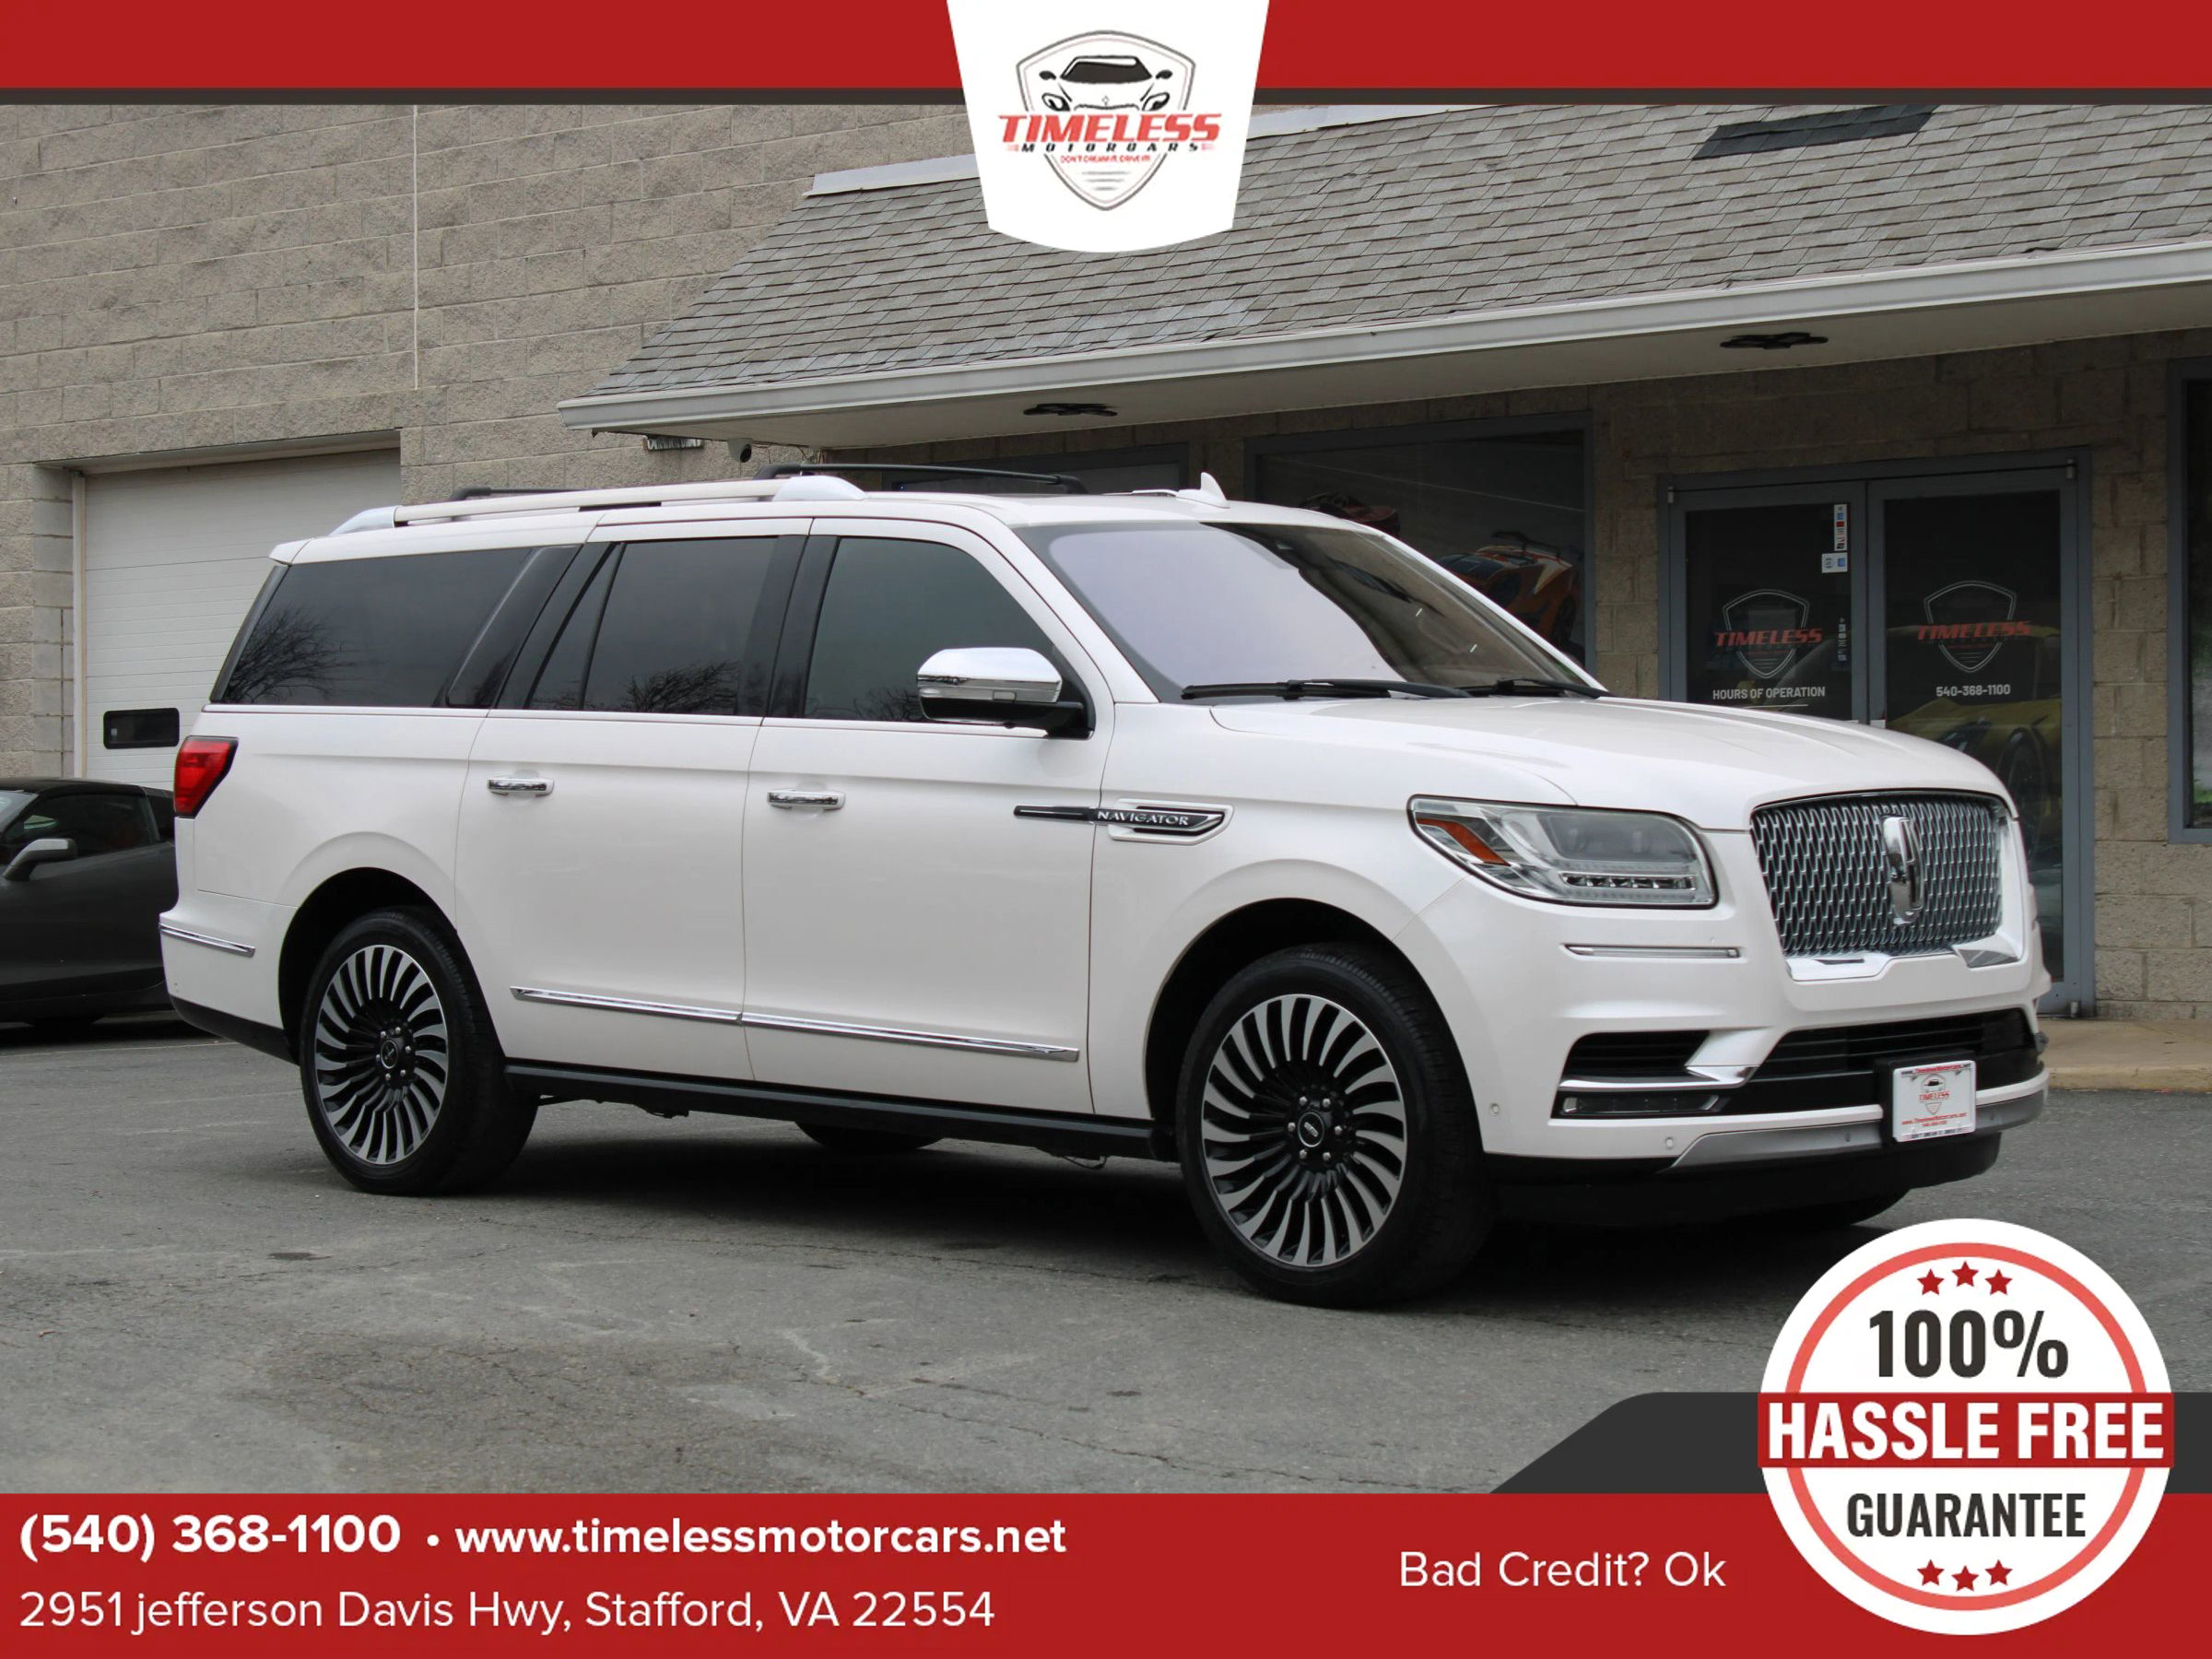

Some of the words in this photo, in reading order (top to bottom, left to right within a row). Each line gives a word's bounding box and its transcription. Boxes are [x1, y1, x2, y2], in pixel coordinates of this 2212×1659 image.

[1714, 628, 1823, 647] TIMELESS
[1917, 620, 2032, 640] TIMELESS
[1712, 689, 1747, 700] HOURS
[1749, 688, 1763, 699] OF
[1765, 687, 1826, 698] OPERATION
[1936, 684, 2011, 697] 540-368-1100
[1098, 811, 1189, 826] NAVIGATOR
